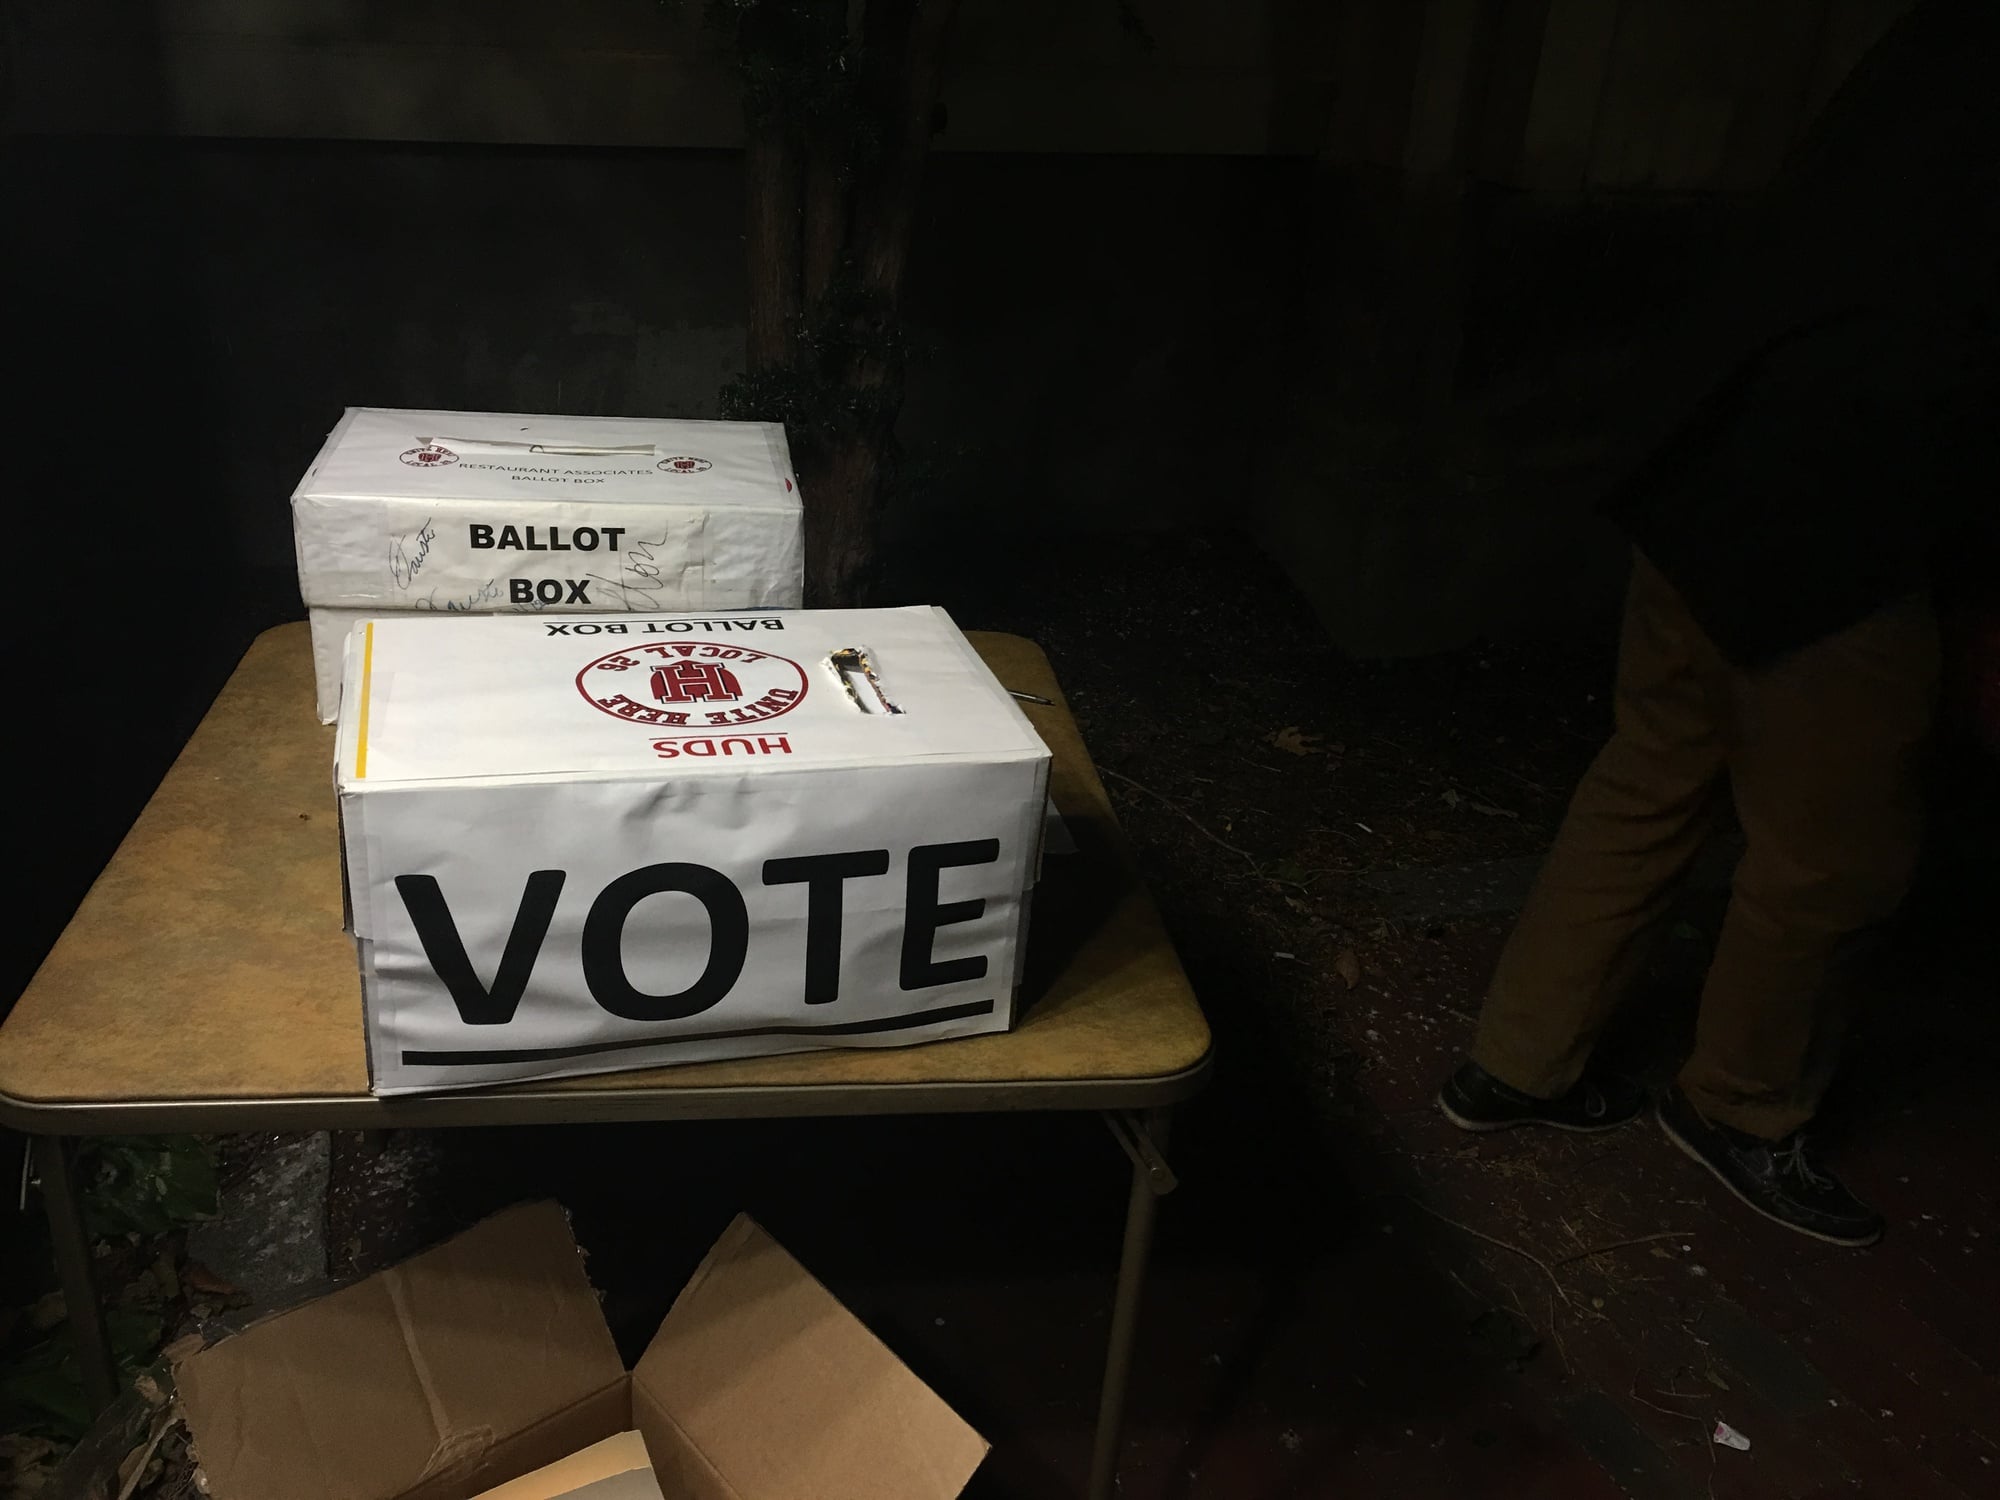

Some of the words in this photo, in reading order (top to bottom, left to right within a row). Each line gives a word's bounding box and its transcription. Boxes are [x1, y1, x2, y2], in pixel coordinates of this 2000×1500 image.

[459, 463, 560, 475] RESTAURANT
[511, 475, 569, 483] BALLOT
[469, 523, 626, 552] BALLOT
[509, 578, 592, 605] BOX
[547, 623, 629, 636] BOX
[642, 618, 785, 633] BALLOT
[597, 655, 640, 672] 26
[644, 645, 770, 664] LOCAL
[597, 693, 691, 725] HERE
[704, 687, 799, 725] UNITE
[652, 736, 793, 759] HUDS
[394, 838, 1001, 1026] VOTE
